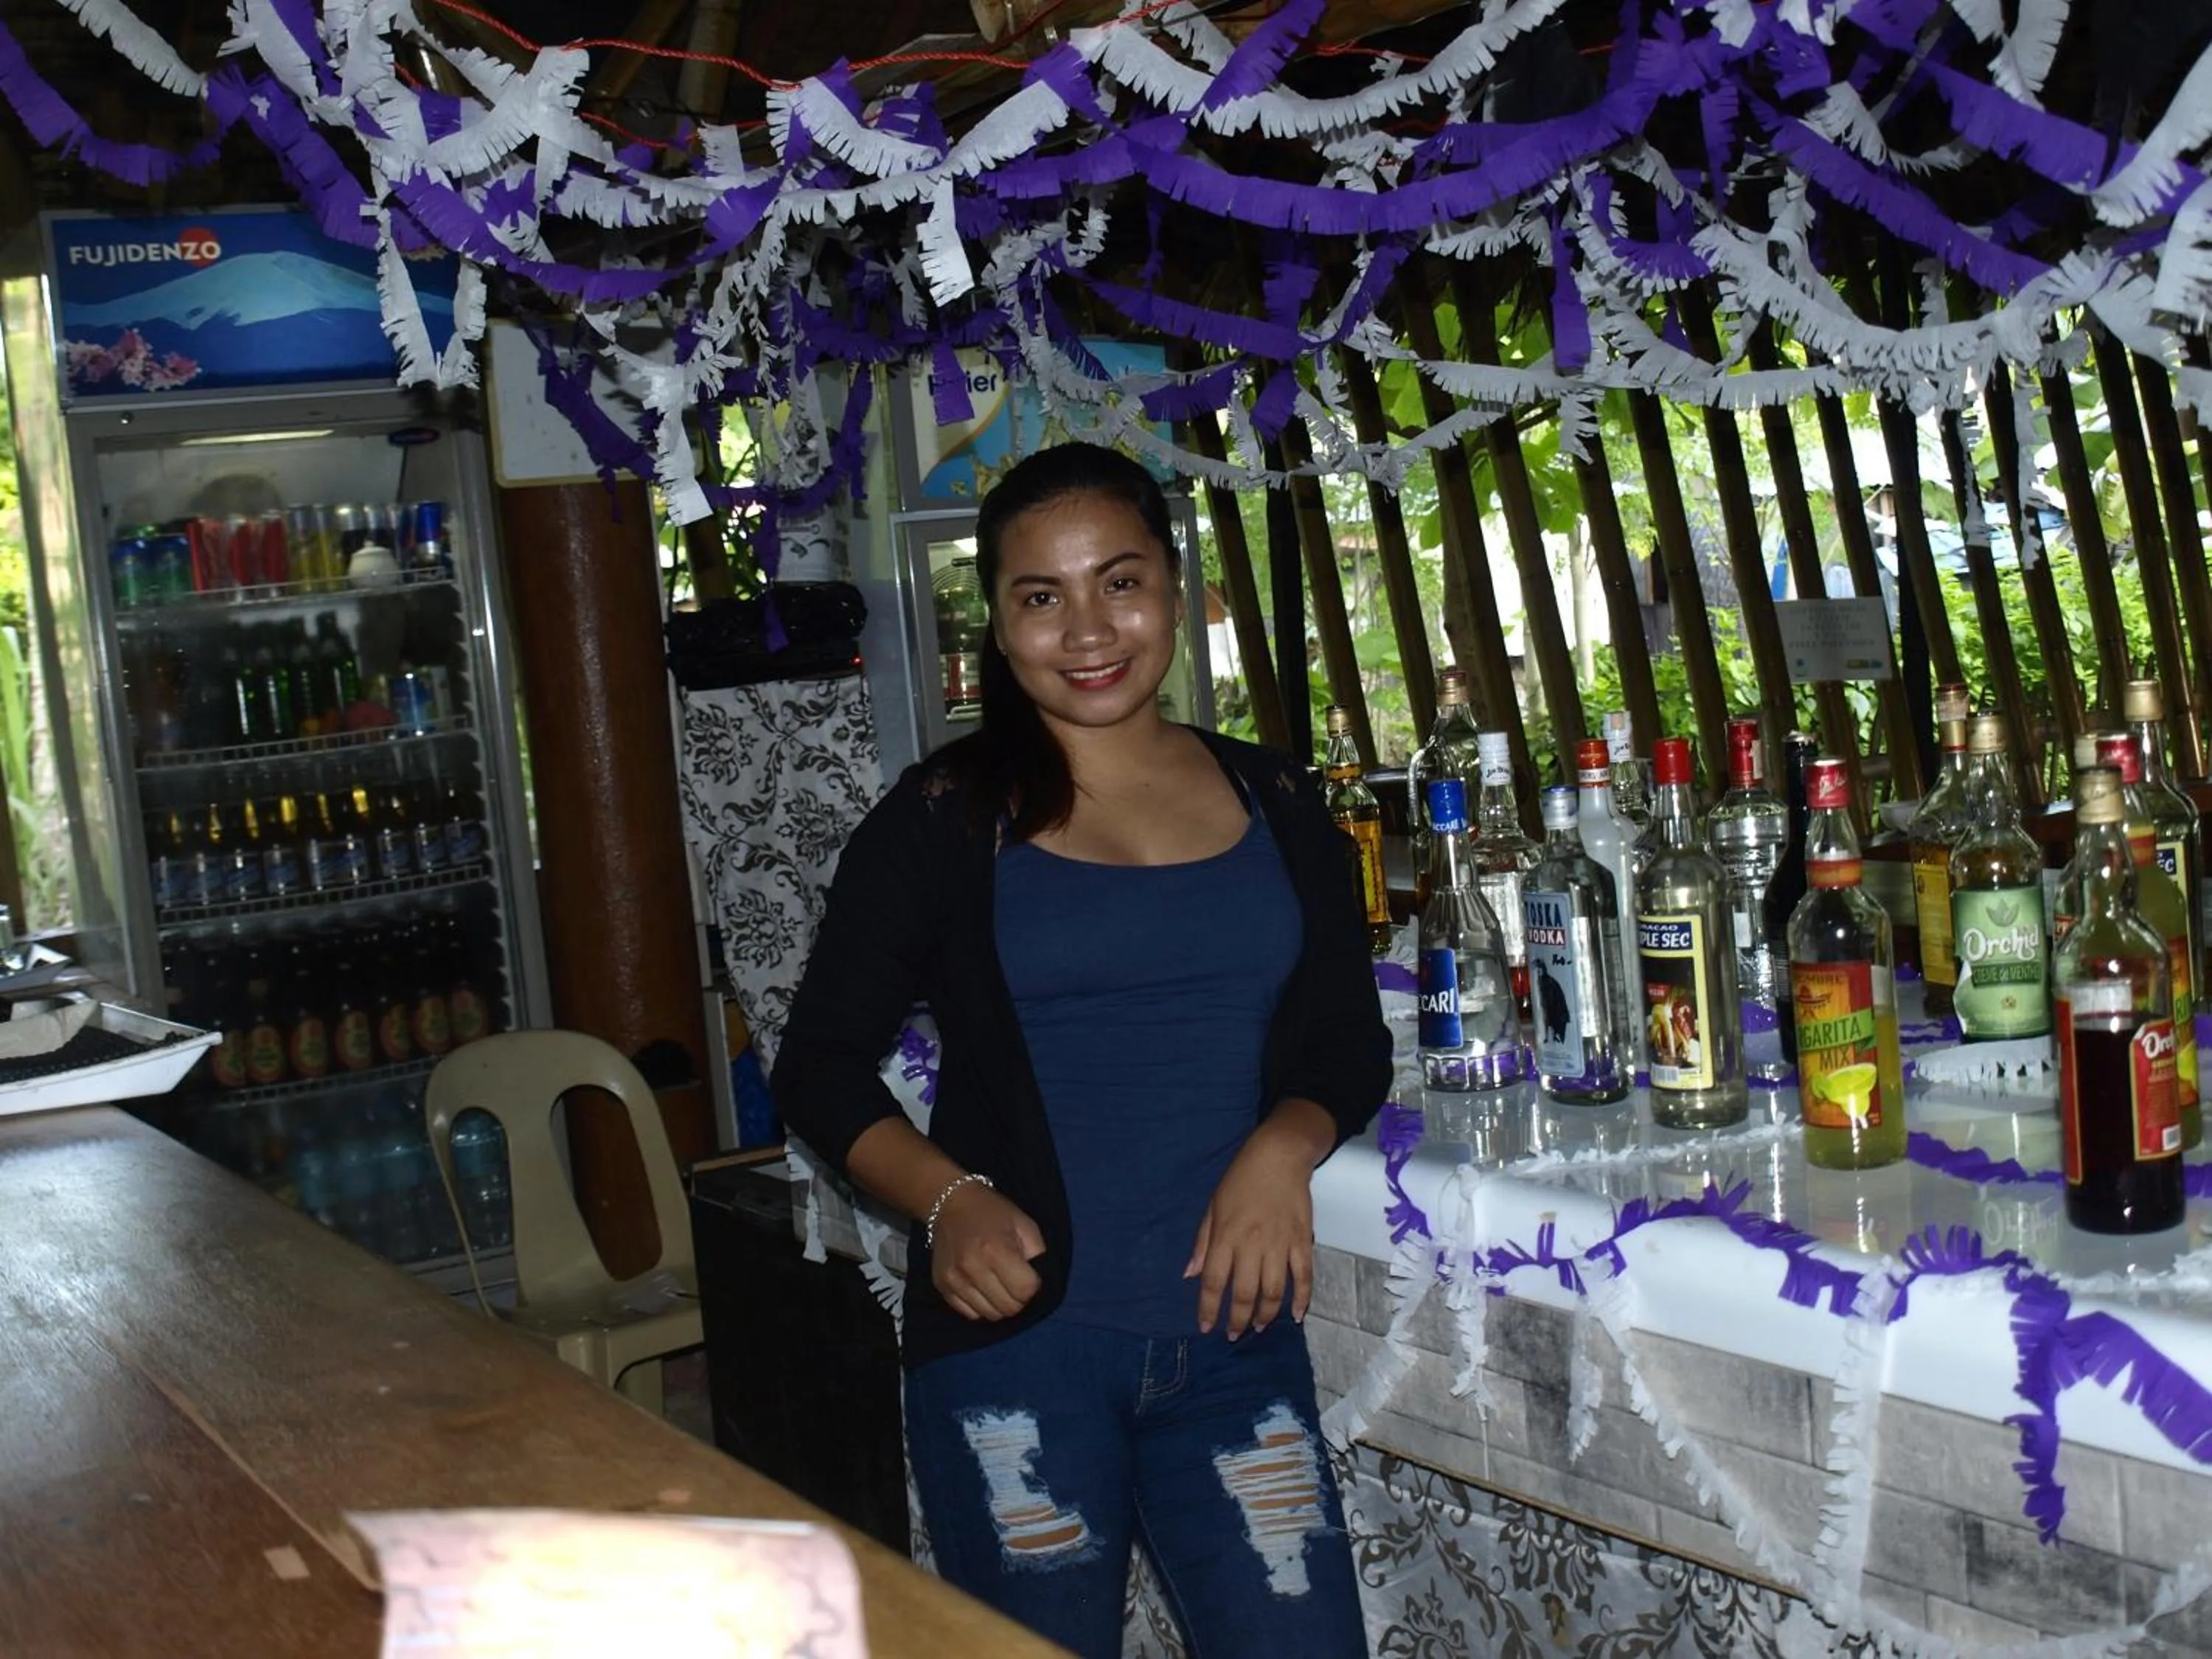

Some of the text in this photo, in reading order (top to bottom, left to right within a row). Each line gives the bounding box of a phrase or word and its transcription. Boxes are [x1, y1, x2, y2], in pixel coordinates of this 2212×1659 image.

[69, 241, 221, 267] FUJIDENZO
[928, 370, 997, 396] Hier
[1528, 930, 1564, 945] VODKA
[1661, 932, 1691, 947] SEC
[1964, 924, 2039, 961] Orchid
[1820, 1046, 1849, 1070] MIX
